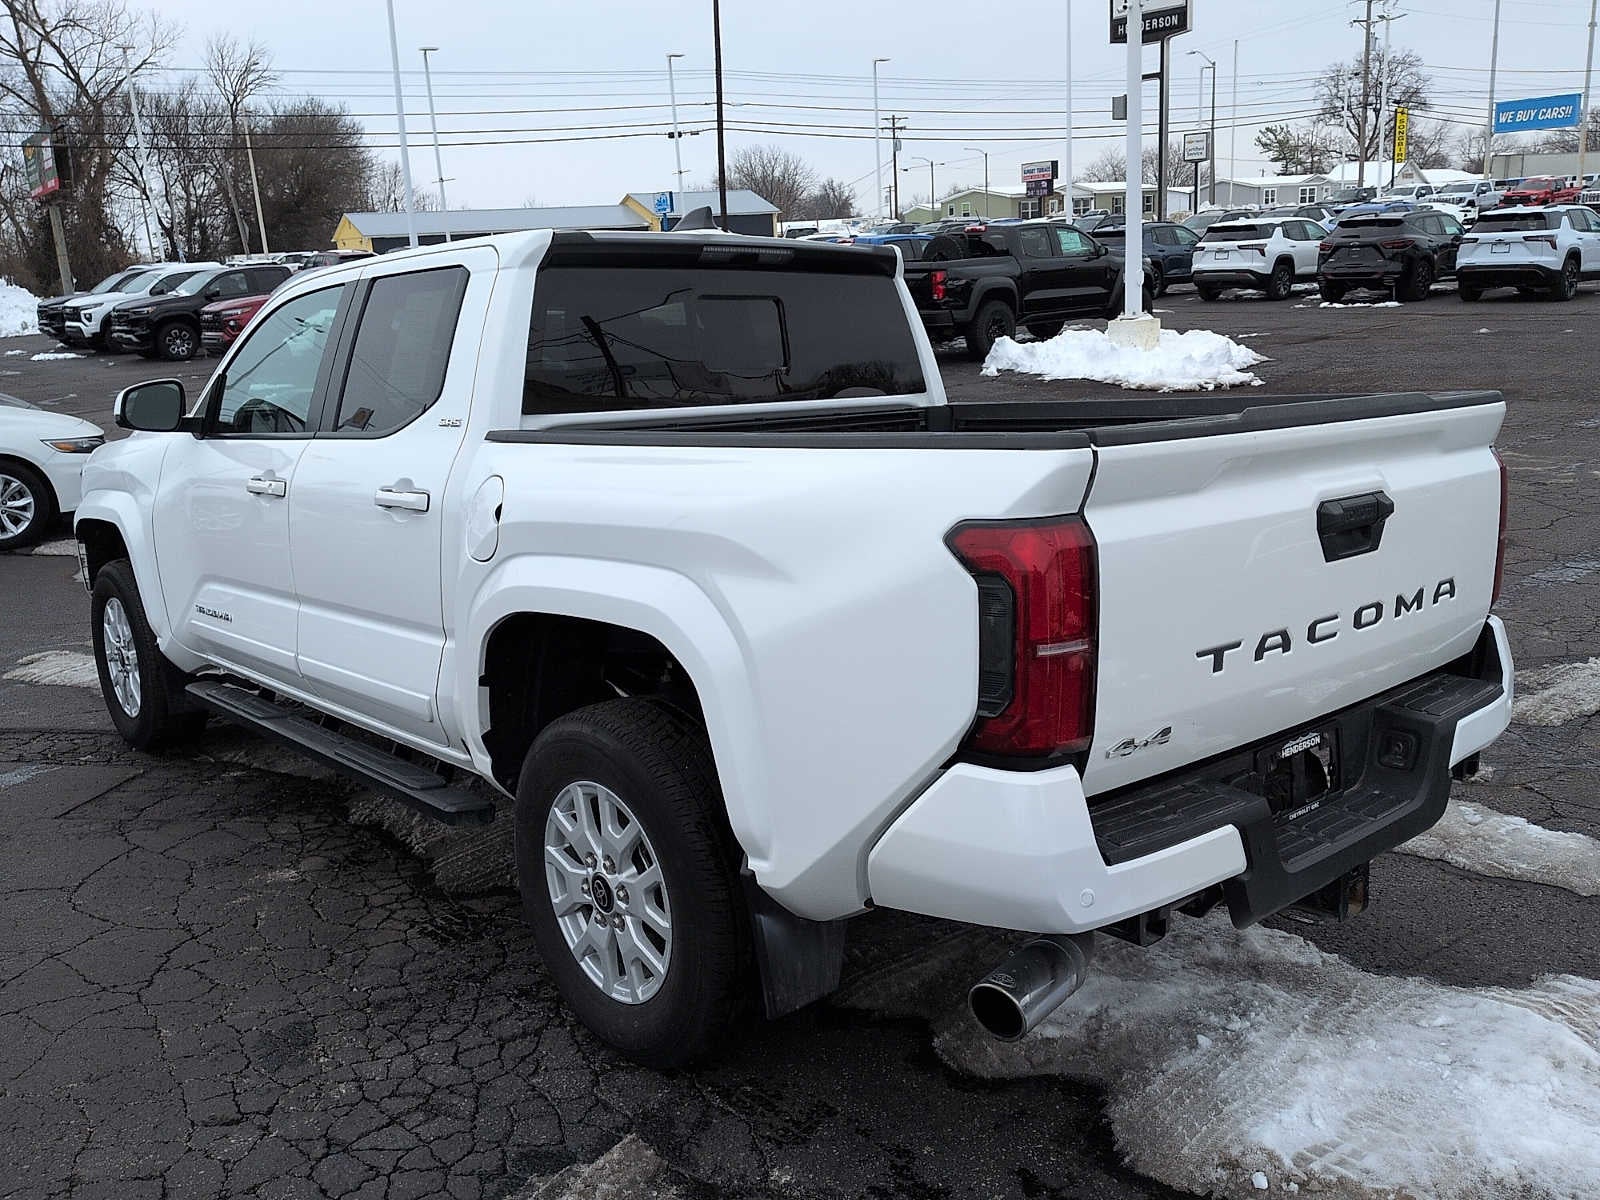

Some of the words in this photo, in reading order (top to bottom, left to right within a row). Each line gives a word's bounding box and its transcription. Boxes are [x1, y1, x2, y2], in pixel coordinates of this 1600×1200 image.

[1118, 14, 1178, 35] HDERSON
[1499, 111, 1515, 123] WE
[1515, 109, 1538, 122] BUY
[1538, 105, 1573, 120] CARS!!
[1196, 576, 1456, 674] TACOMA
[1281, 735, 1320, 759] HENDERSON
